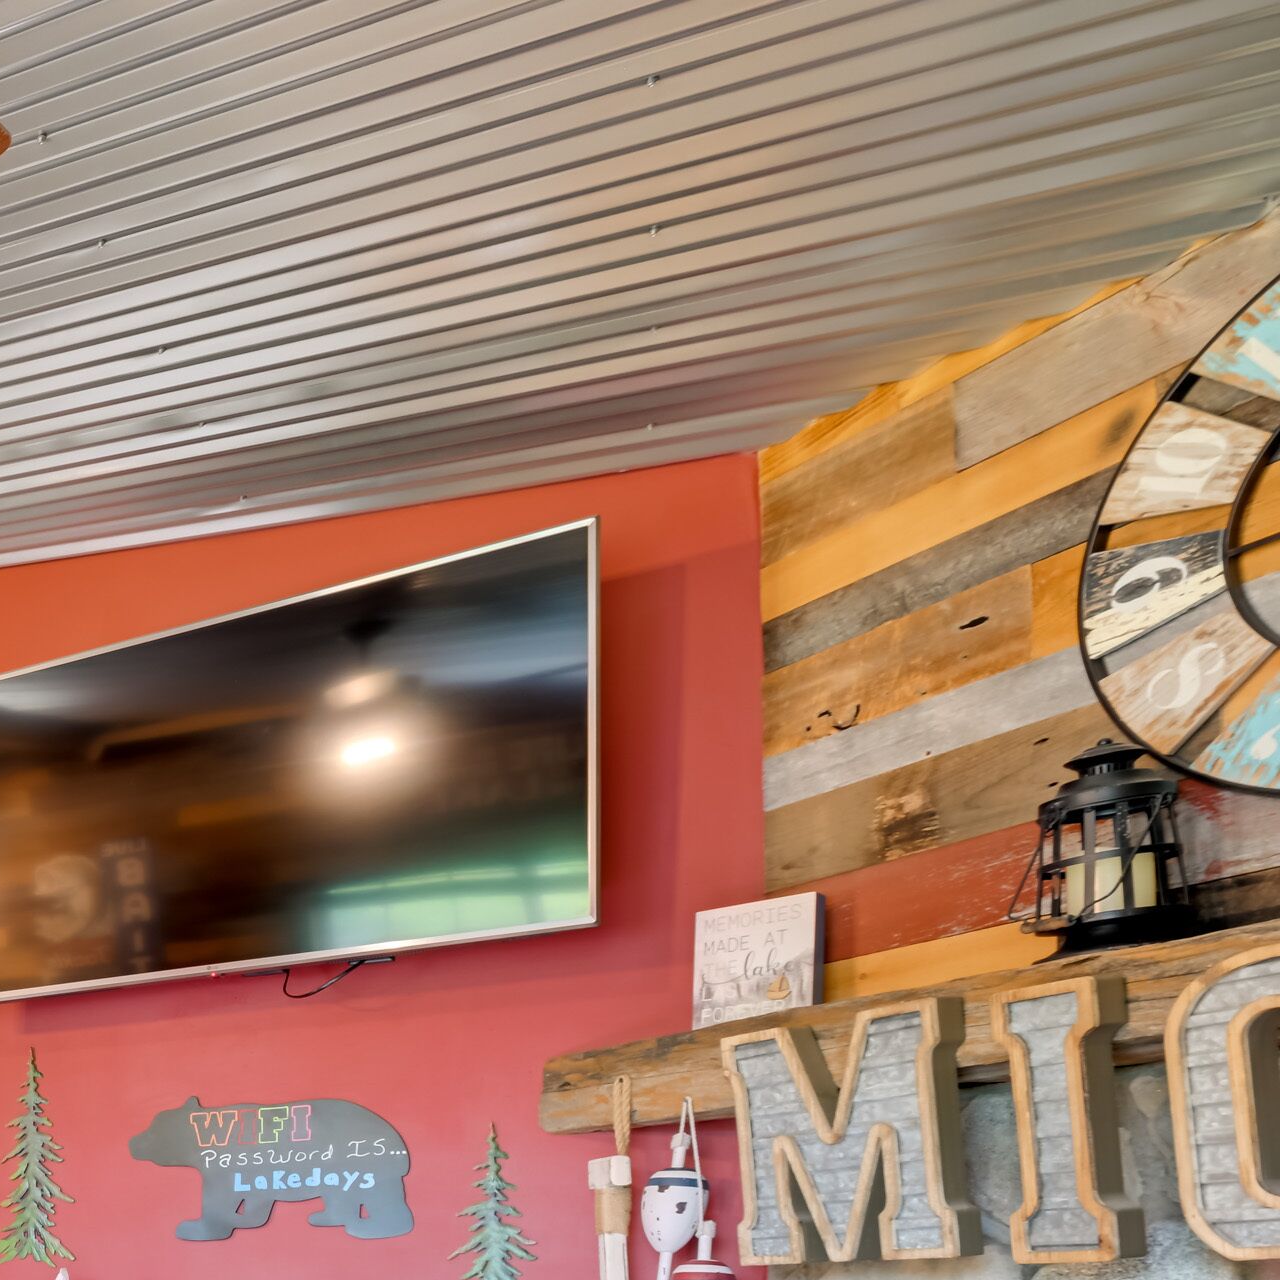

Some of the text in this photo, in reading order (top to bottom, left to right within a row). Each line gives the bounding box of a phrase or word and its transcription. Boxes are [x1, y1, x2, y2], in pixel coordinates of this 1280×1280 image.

[703, 903, 803, 934] MEMORIES
[703, 929, 788, 956] MADE AT
[743, 948, 796, 981] lake
